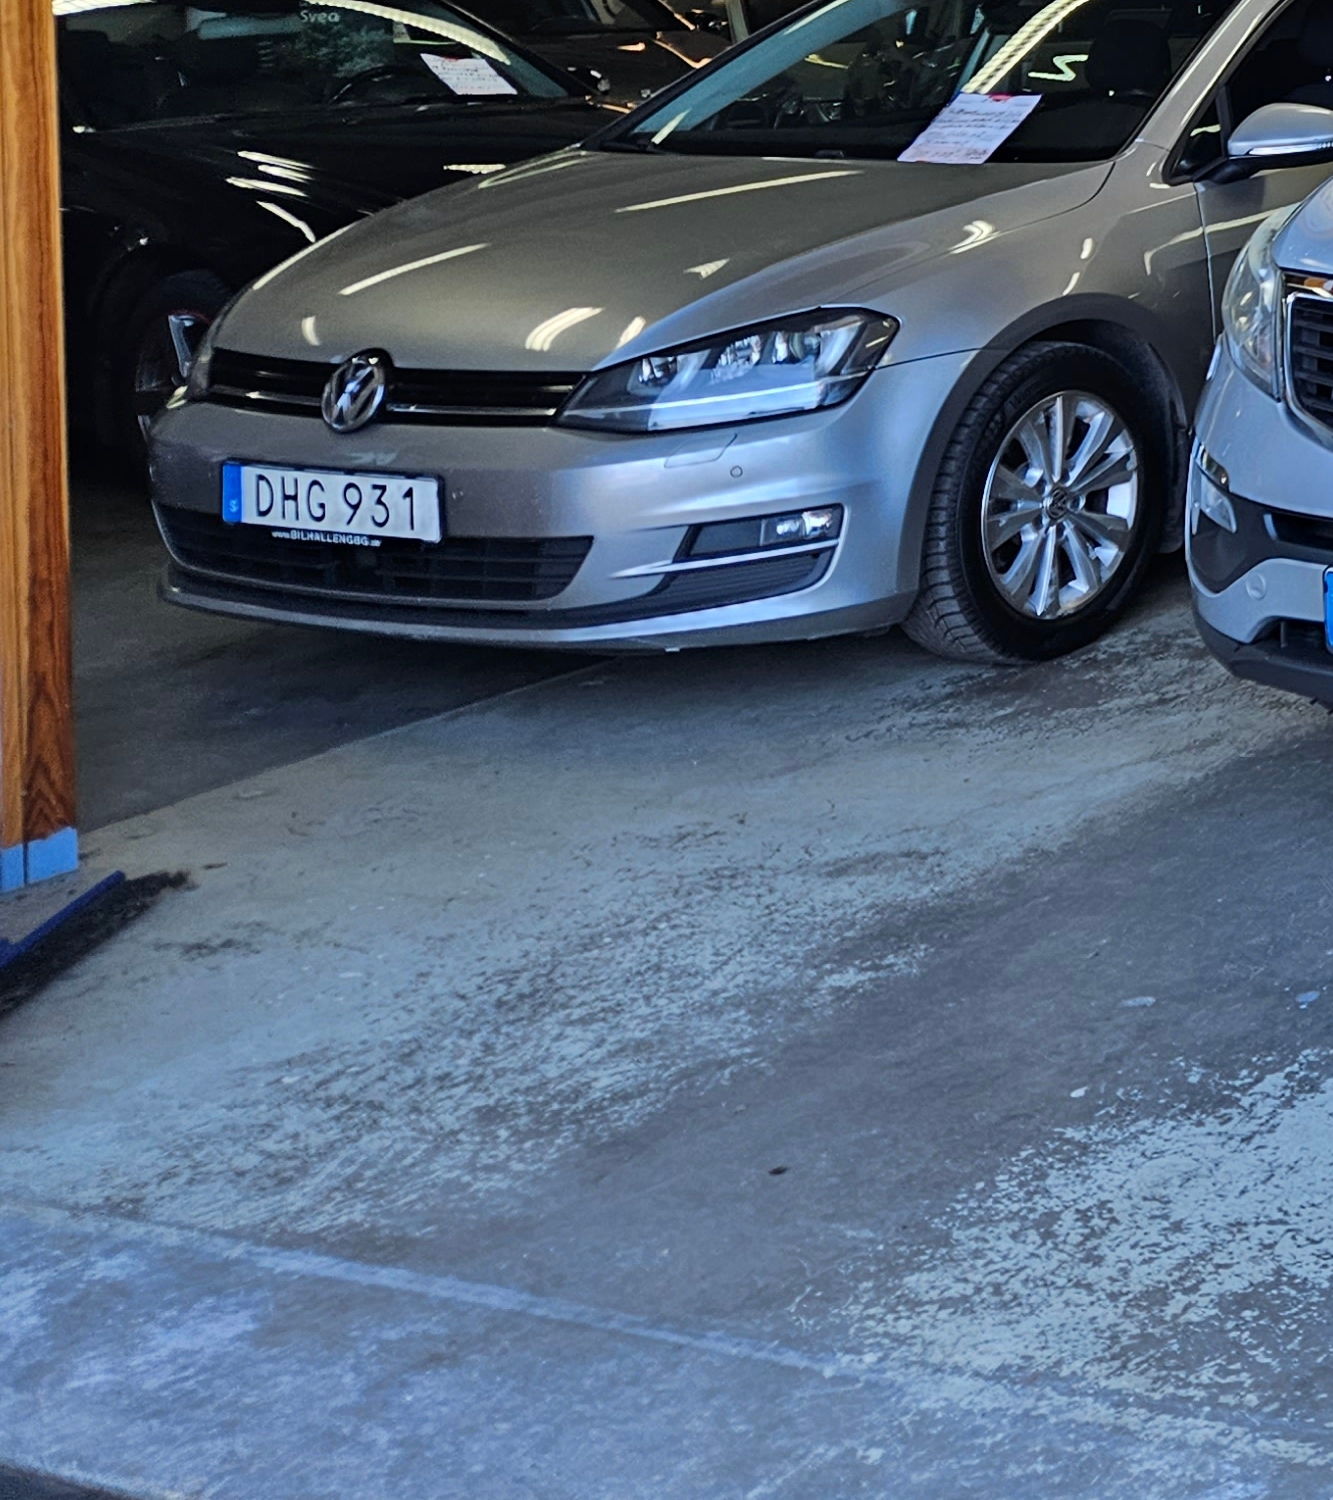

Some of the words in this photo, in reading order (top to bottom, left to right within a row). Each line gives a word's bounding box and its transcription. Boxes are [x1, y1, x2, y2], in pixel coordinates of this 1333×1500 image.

[300, 10, 341, 24] Svea
[255, 473, 326, 523] DHG
[343, 481, 415, 531] 931
